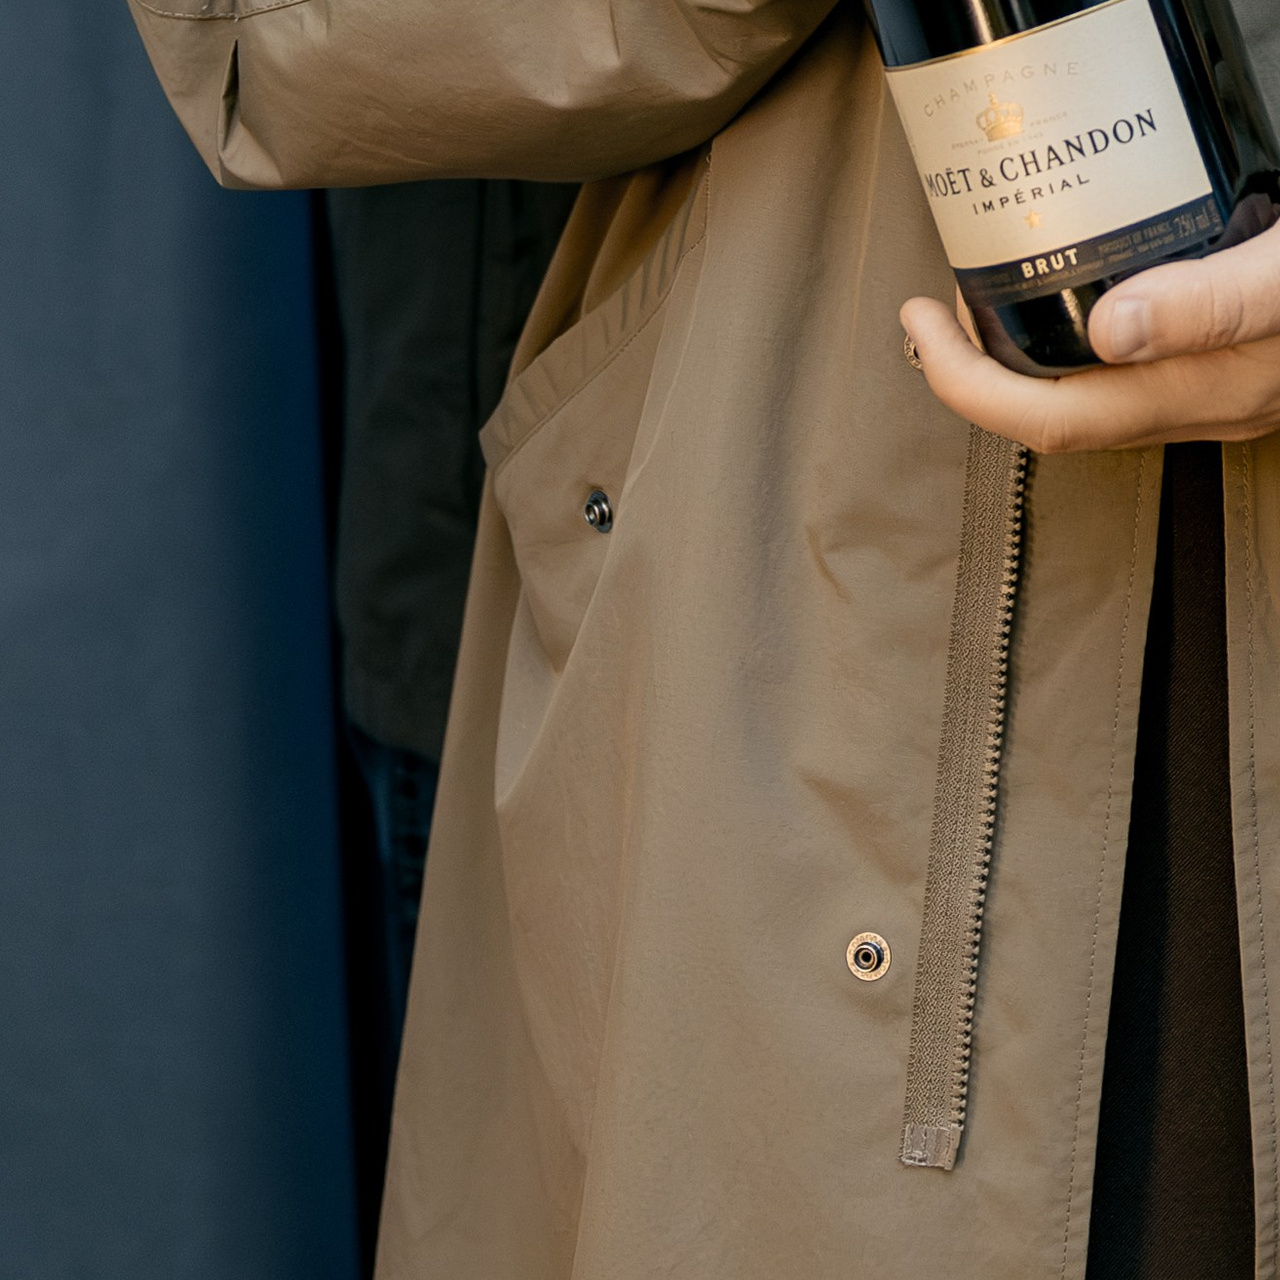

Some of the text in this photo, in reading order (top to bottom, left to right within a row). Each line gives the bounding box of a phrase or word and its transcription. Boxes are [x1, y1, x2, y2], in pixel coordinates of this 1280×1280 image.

[923, 61, 1080, 118] CHAMPAGNE
[980, 168, 996, 189] &
[1000, 107, 1158, 182] CHANDON
[972, 173, 1091, 216] IMPÉRIAL
[1021, 247, 1079, 279] BRUT
